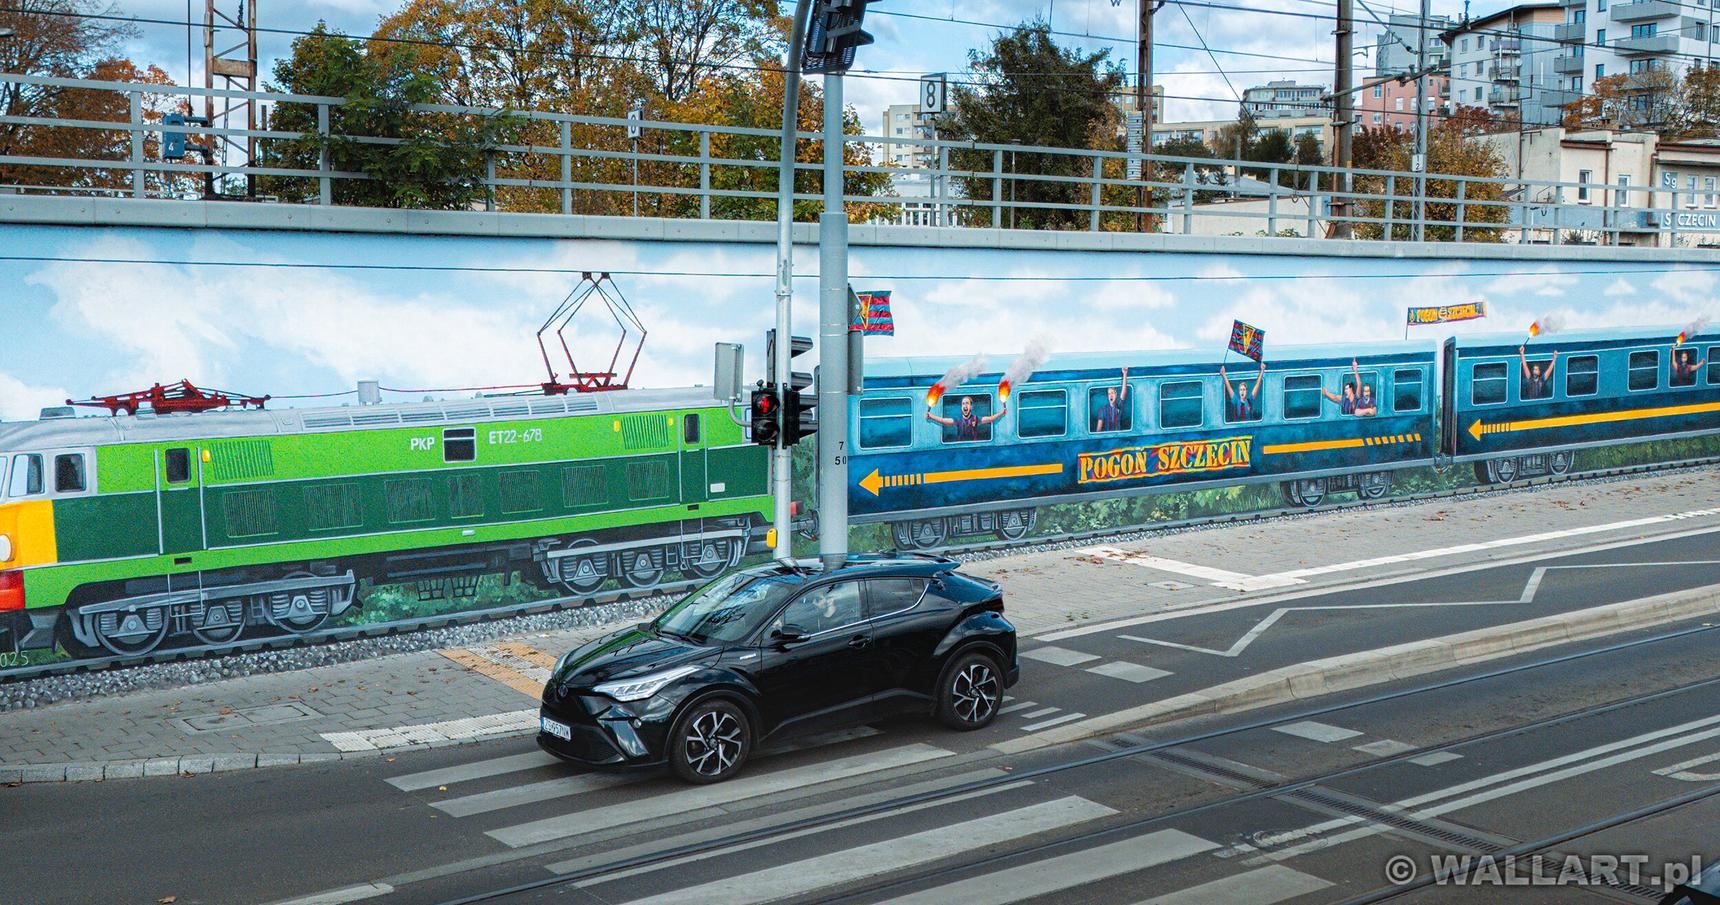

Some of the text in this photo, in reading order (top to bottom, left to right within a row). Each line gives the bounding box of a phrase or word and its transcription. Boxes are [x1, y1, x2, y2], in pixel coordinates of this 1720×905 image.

[926, 80, 936, 109] 8
[1664, 172, 1678, 189] Sg
[1665, 212, 1717, 227] SCZECIN
[410, 427, 543, 451] PKP ET22-678
[838, 441, 845, 451] 7
[834, 455, 847, 466] 50
[1157, 439, 1251, 471] SZCZECIN
